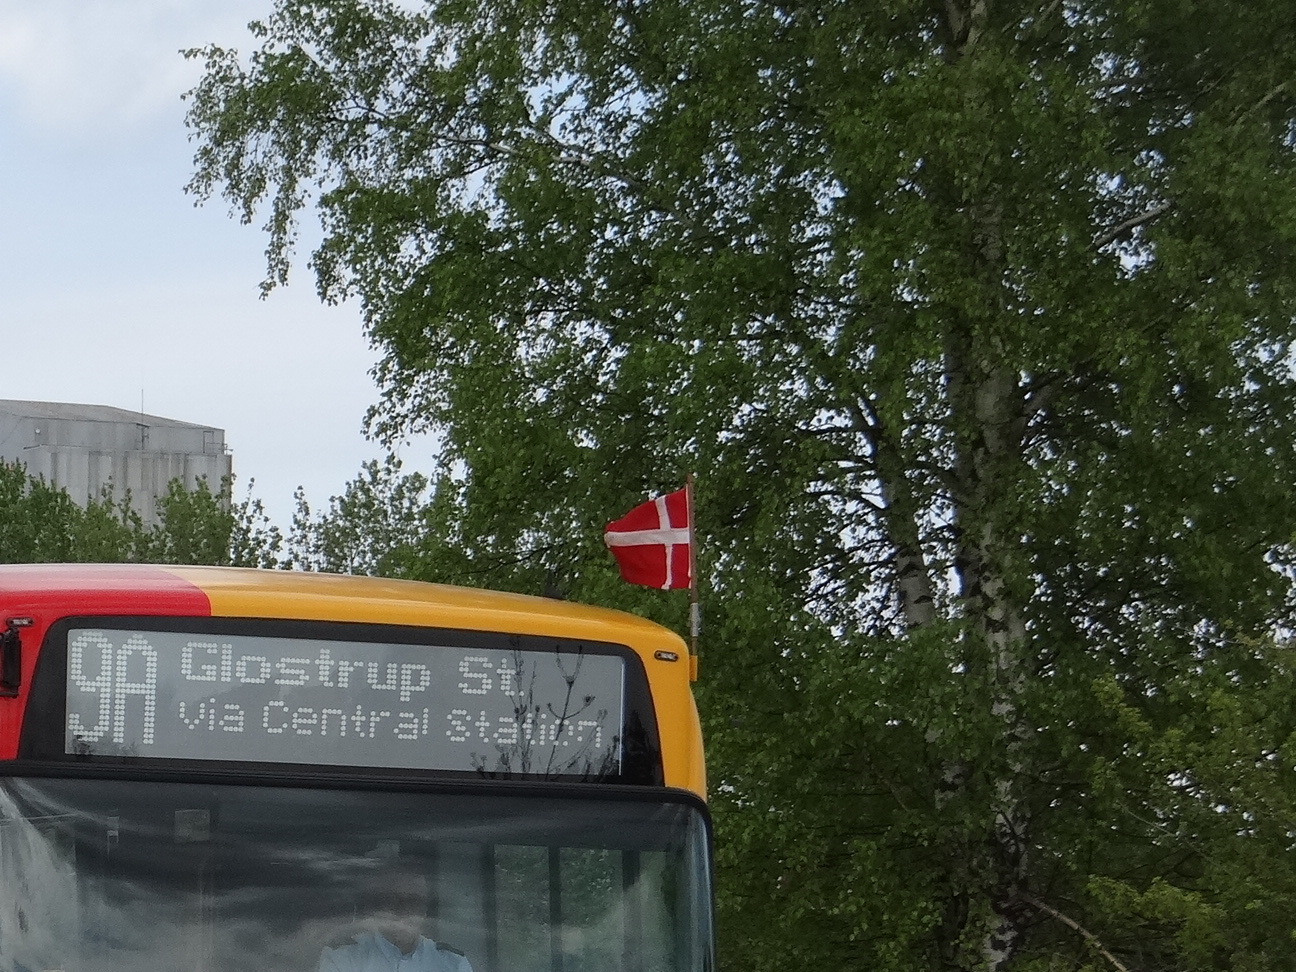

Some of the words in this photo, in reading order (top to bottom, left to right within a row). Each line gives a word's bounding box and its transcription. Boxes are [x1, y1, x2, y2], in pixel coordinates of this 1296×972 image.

[68, 632, 158, 745] 9A
[180, 641, 432, 701] Glostrup
[178, 697, 246, 733] via
[262, 700, 430, 740] Central
[446, 707, 603, 749] Station
